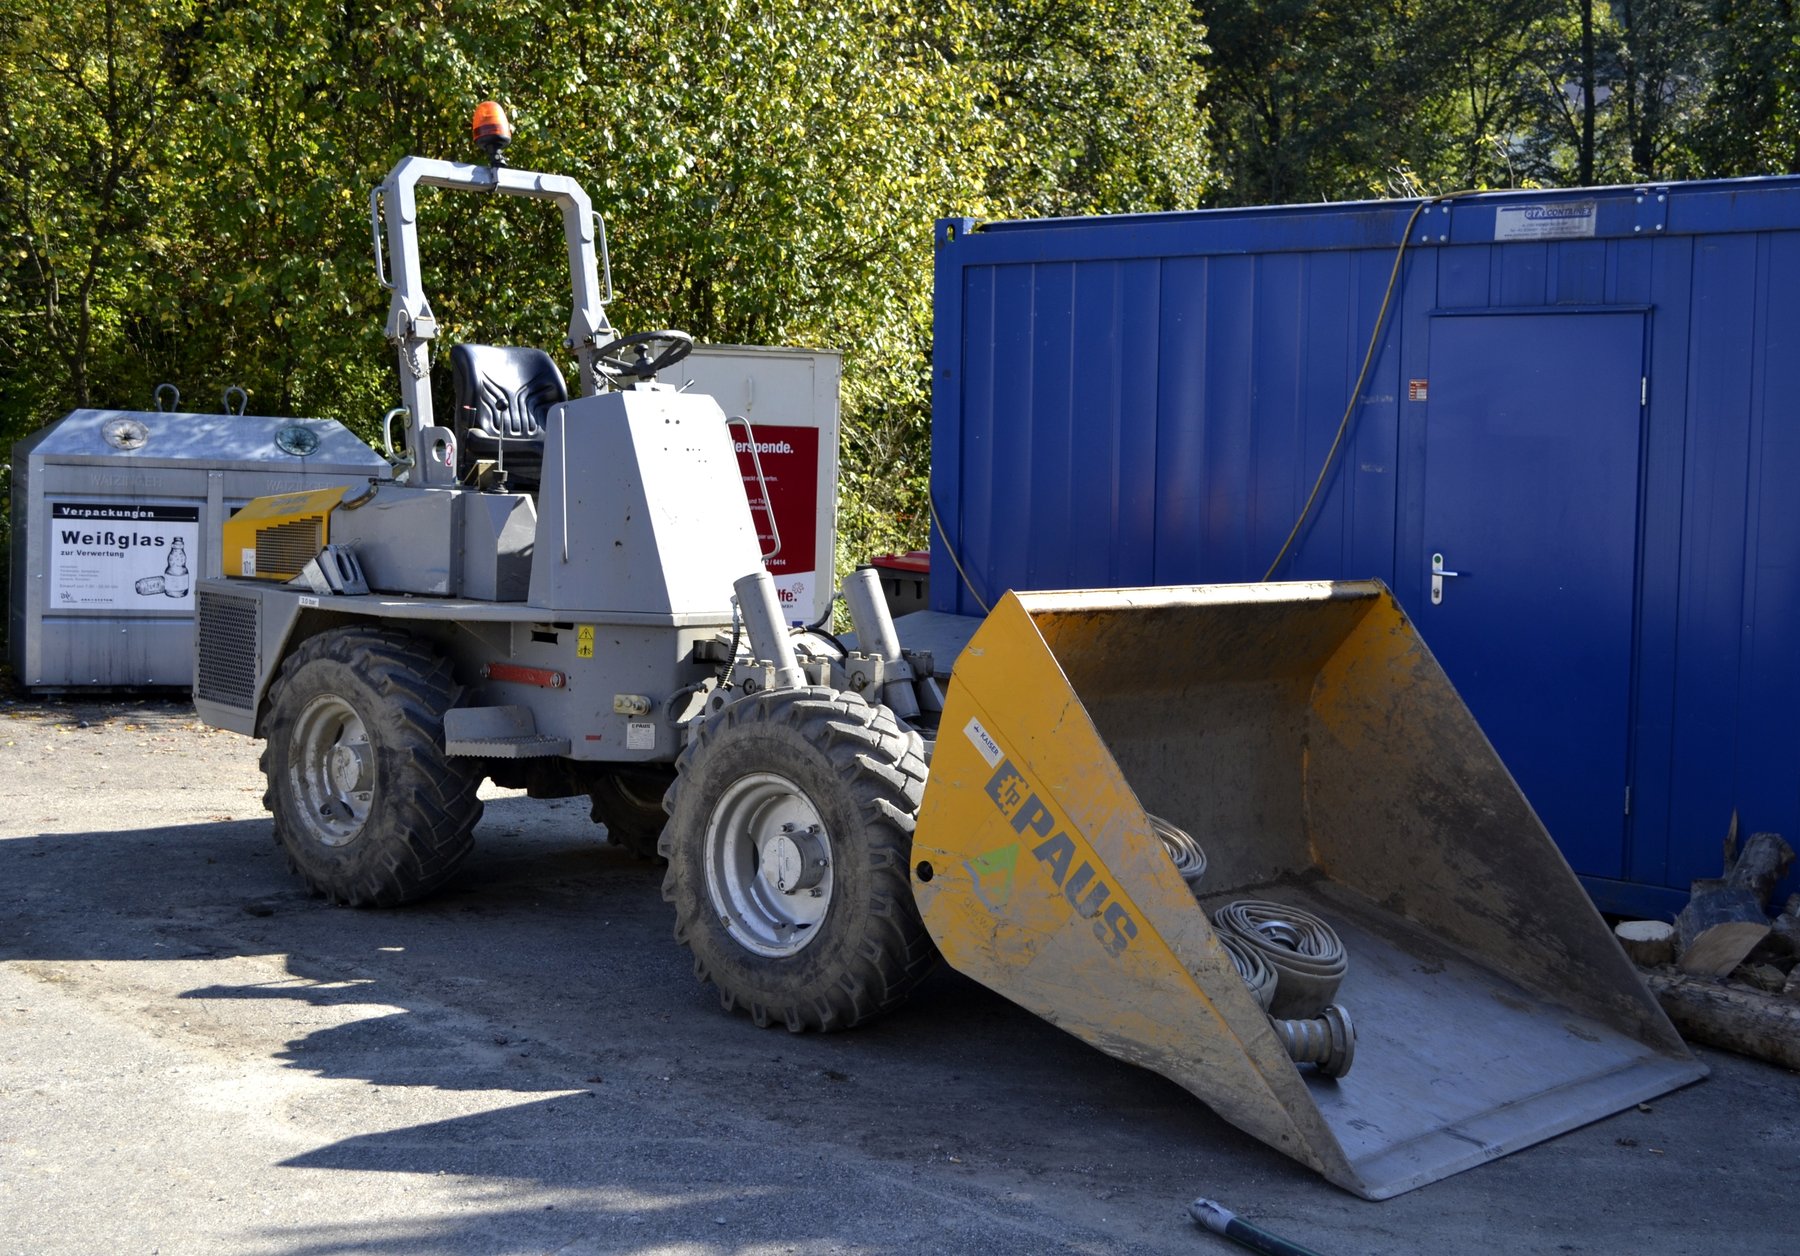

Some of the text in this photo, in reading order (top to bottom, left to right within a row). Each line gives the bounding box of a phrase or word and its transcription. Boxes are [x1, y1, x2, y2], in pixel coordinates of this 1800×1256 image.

[62, 507, 154, 518] Verpackungen
[61, 530, 165, 549] Weißglas
[76, 550, 125, 559] Verwertung
[980, 732, 999, 756] KAISER
[1010, 792, 1139, 959] PAUS
